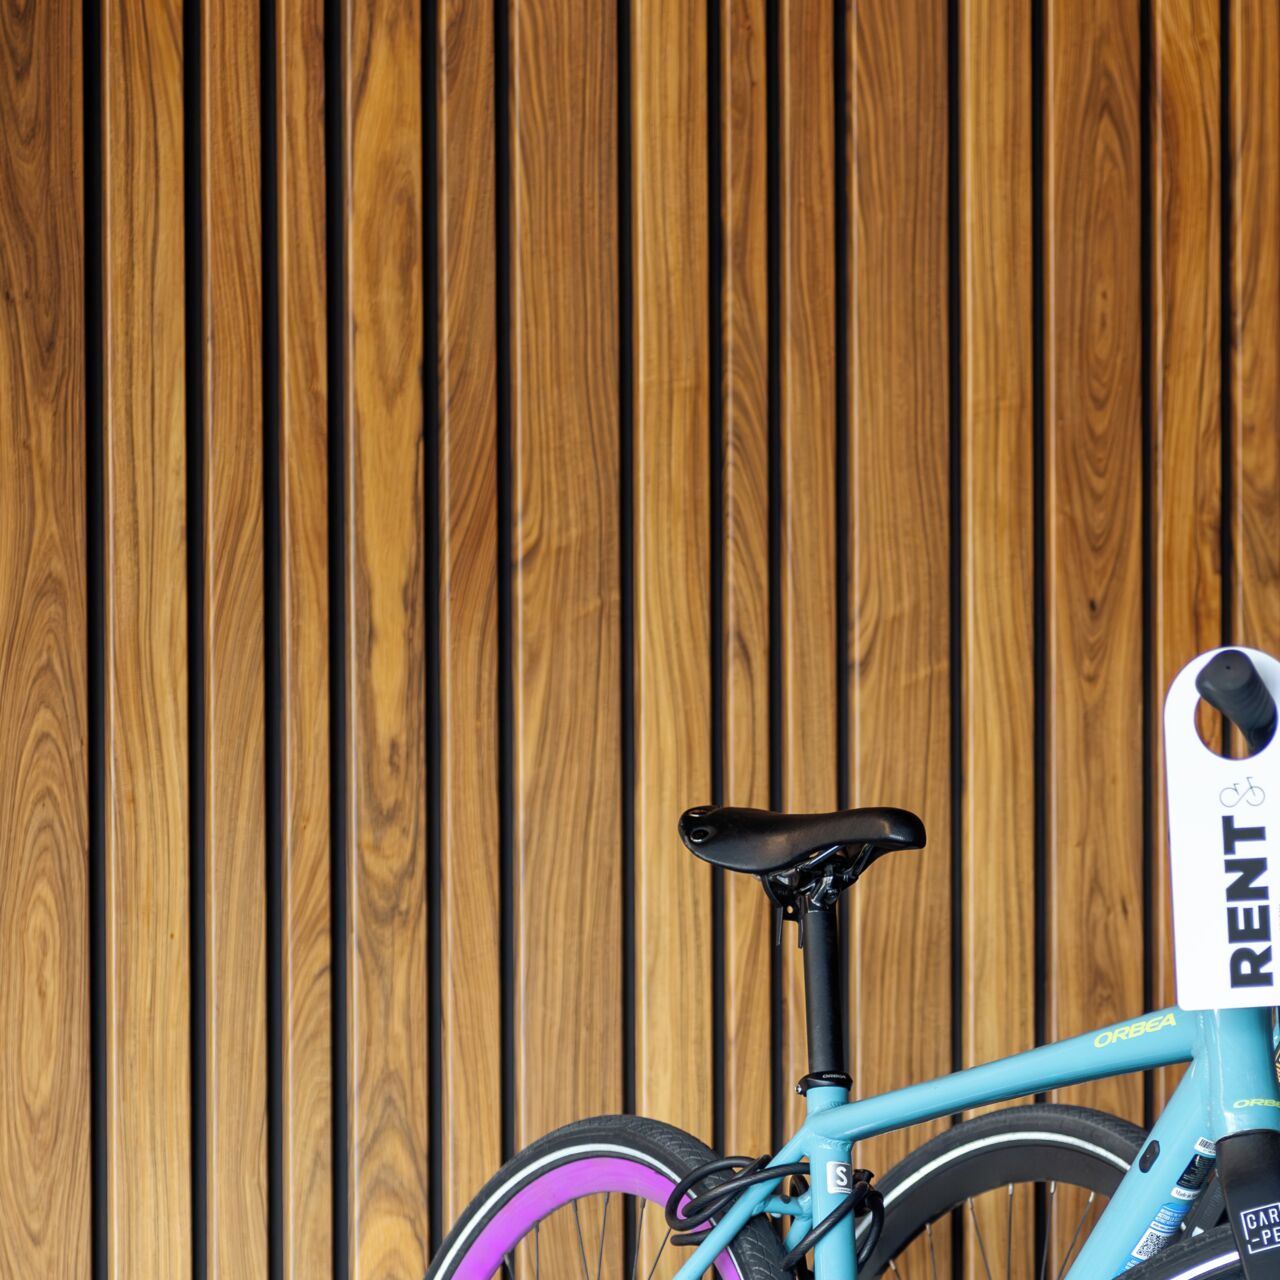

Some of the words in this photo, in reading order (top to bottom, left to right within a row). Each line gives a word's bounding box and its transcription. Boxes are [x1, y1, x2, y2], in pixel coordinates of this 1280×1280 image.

[1222, 815, 1274, 988] RENT
[1094, 1013, 1176, 1048] ORBEA
[836, 1166, 848, 1187] S
[1246, 1208, 1280, 1229] CAR
